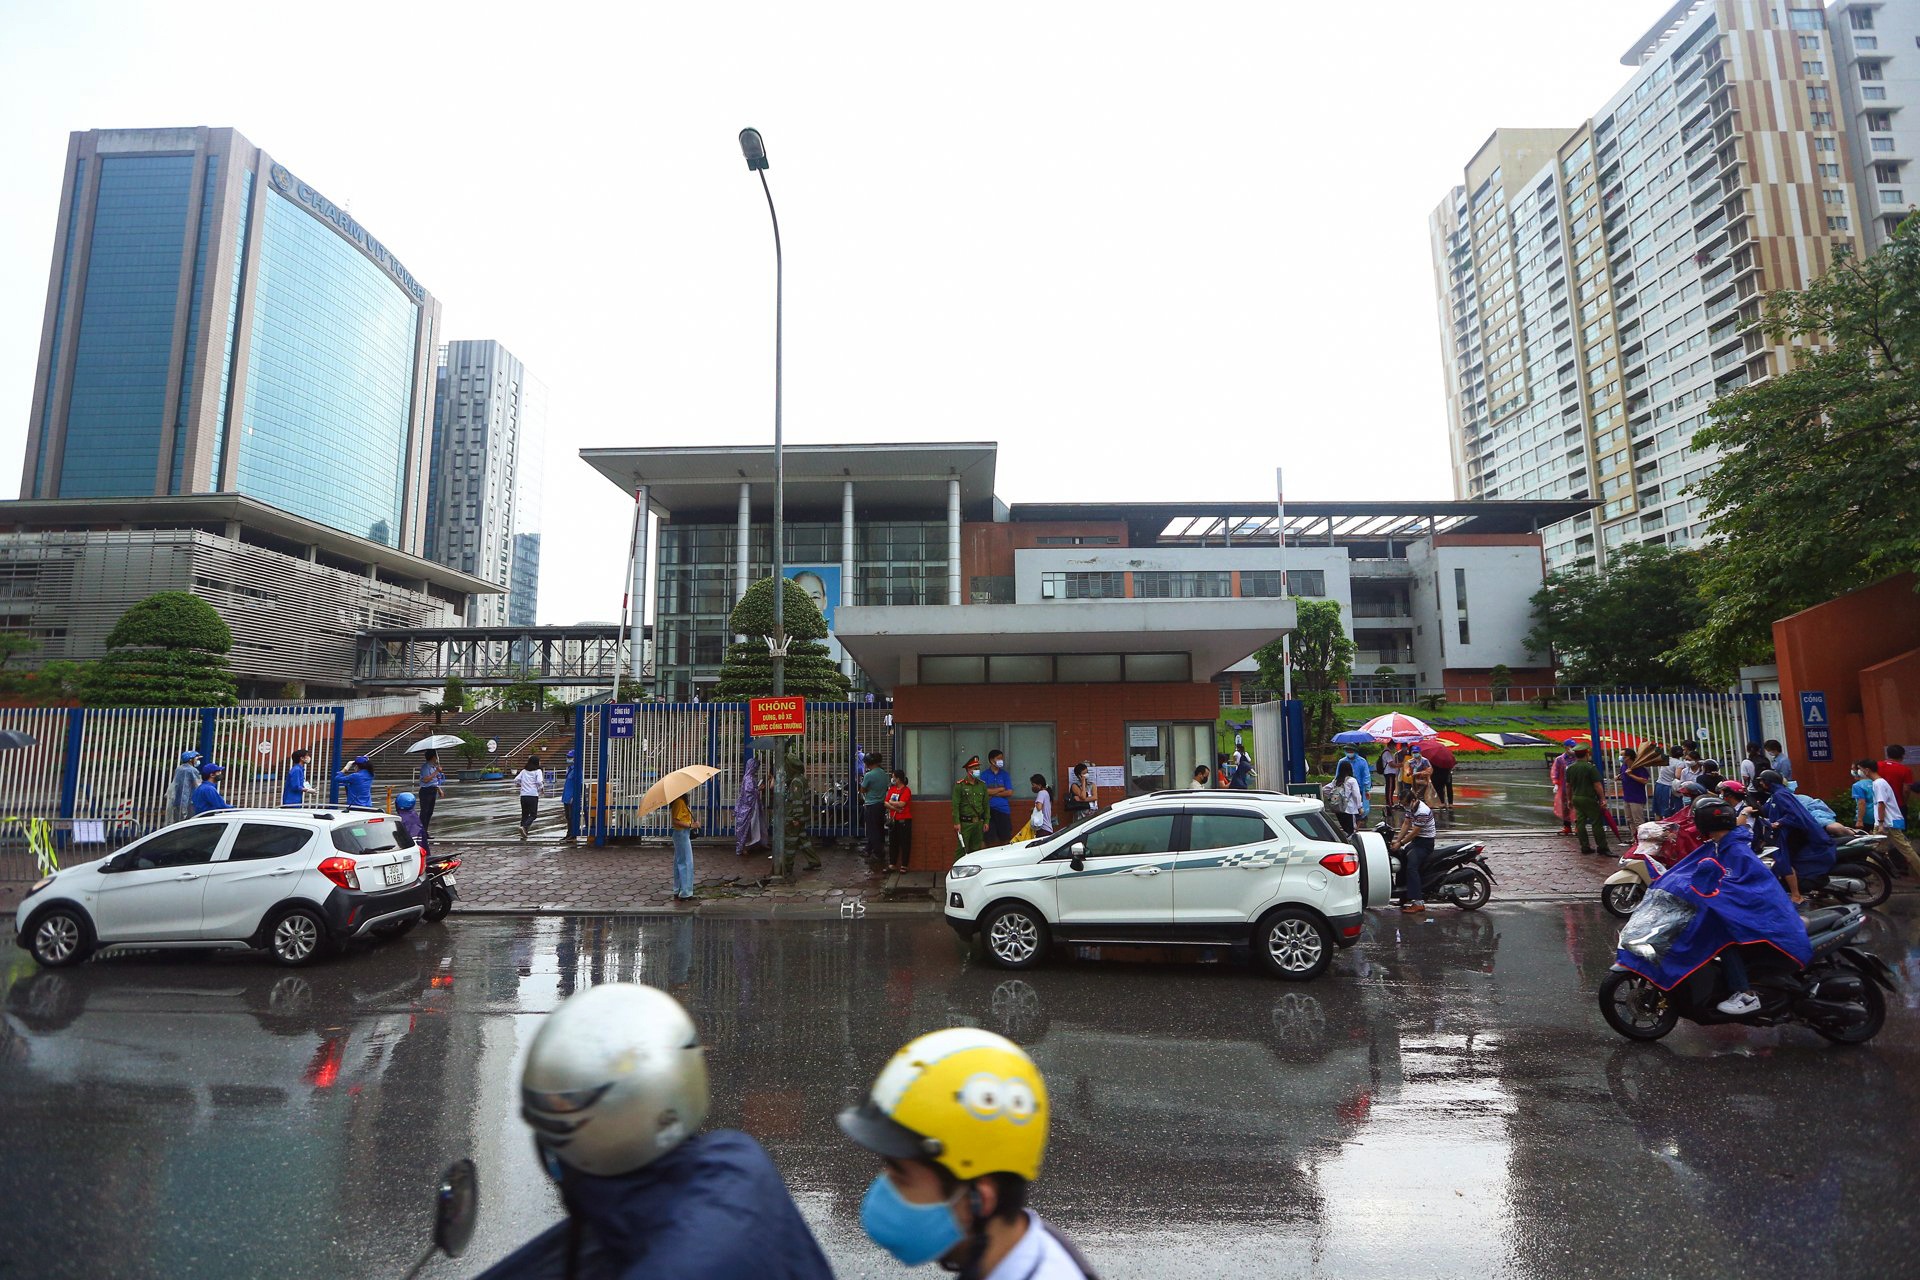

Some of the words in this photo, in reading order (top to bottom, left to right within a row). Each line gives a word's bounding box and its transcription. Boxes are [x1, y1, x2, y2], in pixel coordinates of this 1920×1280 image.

[297, 184, 363, 243] CHARM
[365, 232, 388, 263] VIT
[389, 254, 425, 302] TOWER
[758, 700, 796, 711] KHÔNG
[1807, 705, 1824, 722] A
